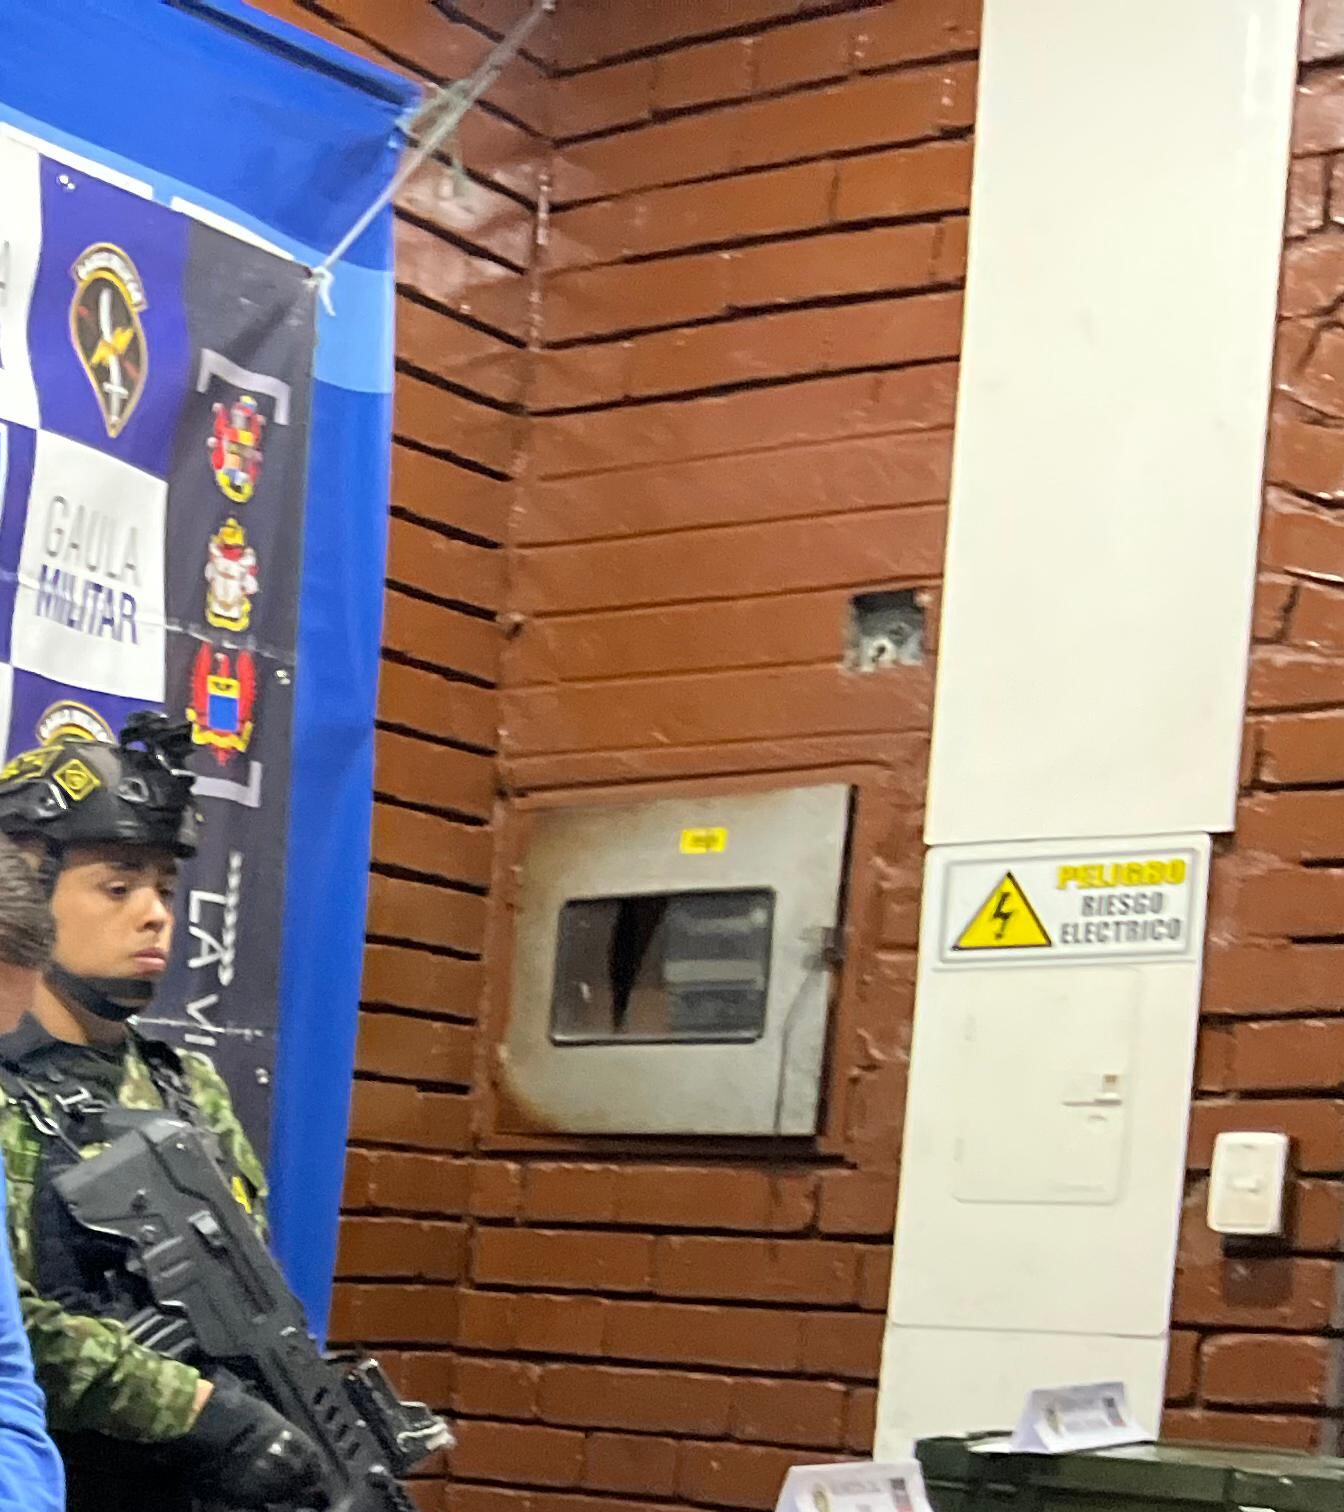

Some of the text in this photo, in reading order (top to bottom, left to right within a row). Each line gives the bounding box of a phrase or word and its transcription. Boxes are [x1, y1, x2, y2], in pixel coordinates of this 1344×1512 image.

[42, 494, 143, 590] GAULA
[34, 564, 139, 646] MILITAR
[1080, 891, 1164, 917] RIESGO
